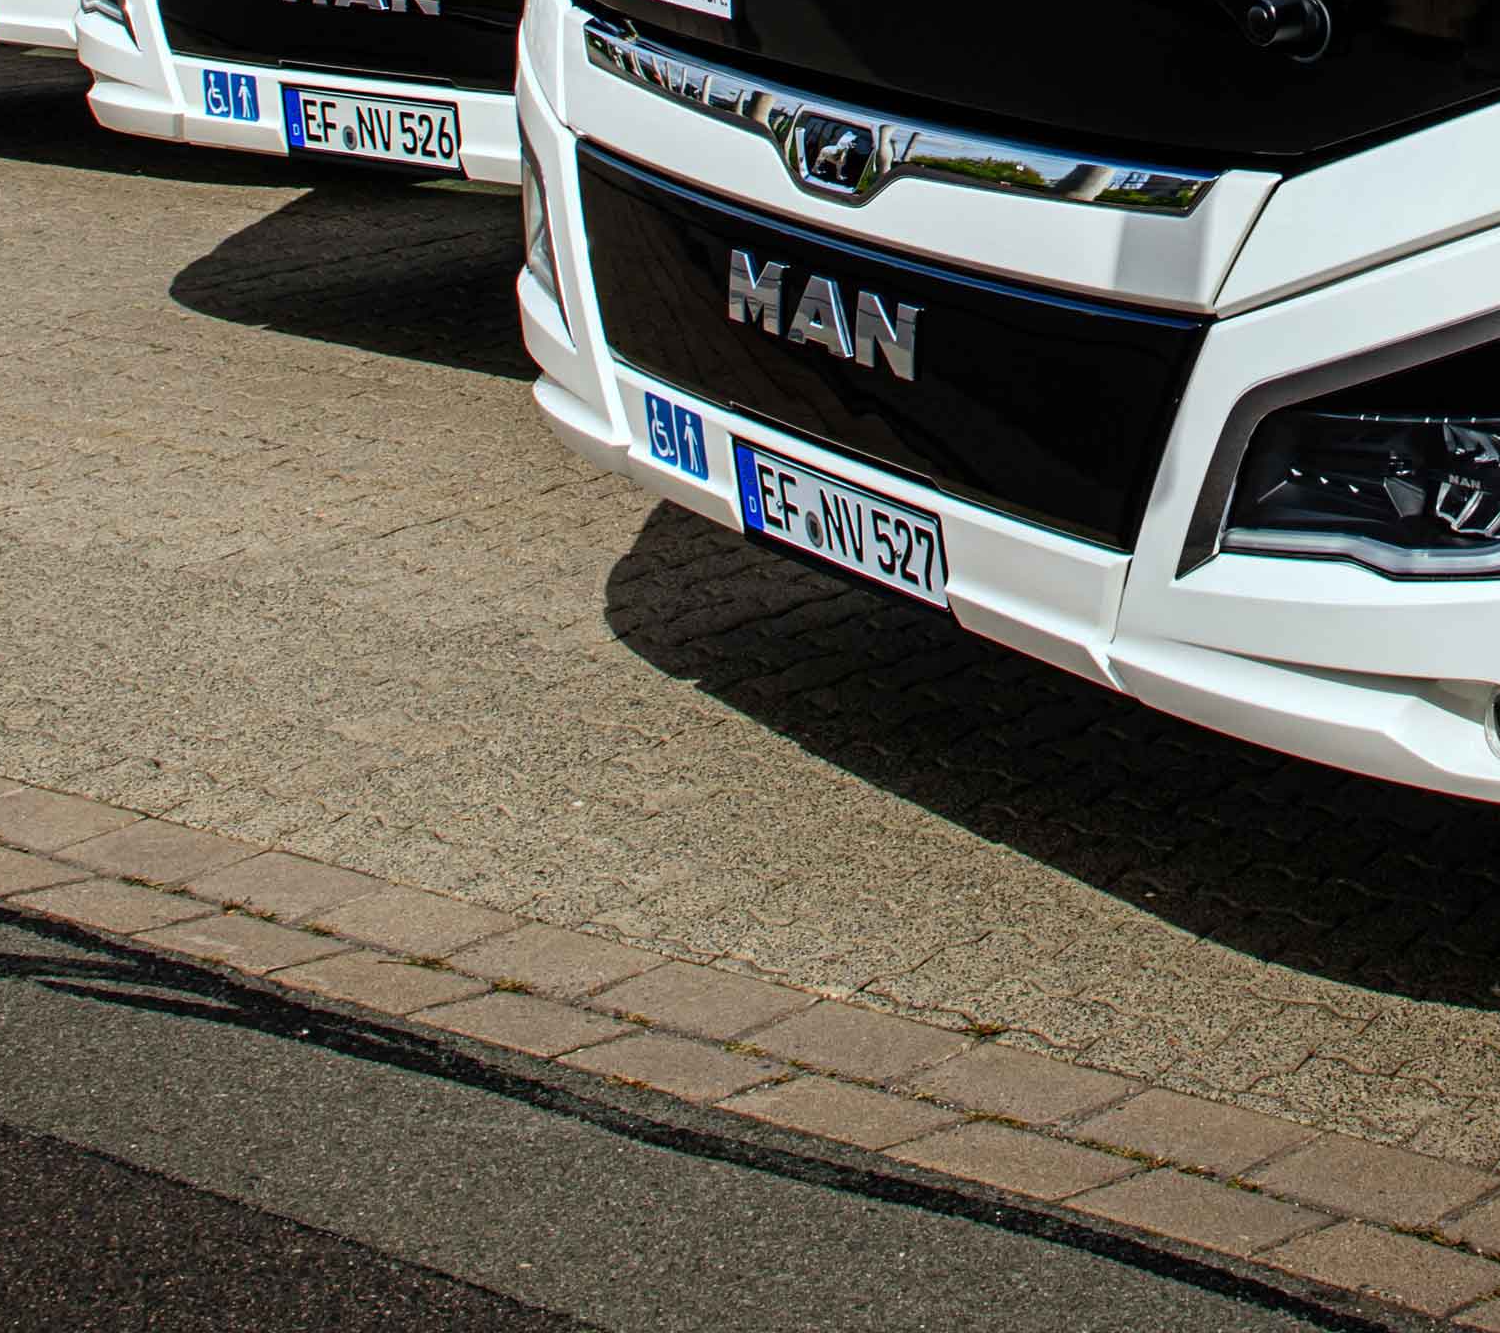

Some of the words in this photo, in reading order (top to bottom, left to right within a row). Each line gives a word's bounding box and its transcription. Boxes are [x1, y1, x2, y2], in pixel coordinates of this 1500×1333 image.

[302, 98, 337, 143] EF
[356, 105, 392, 152] NV
[399, 111, 455, 160] 526
[728, 247, 925, 382] MAN
[748, 495, 757, 513] D
[757, 462, 799, 534] EF
[819, 488, 865, 563] NV
[871, 509, 936, 592] 527
